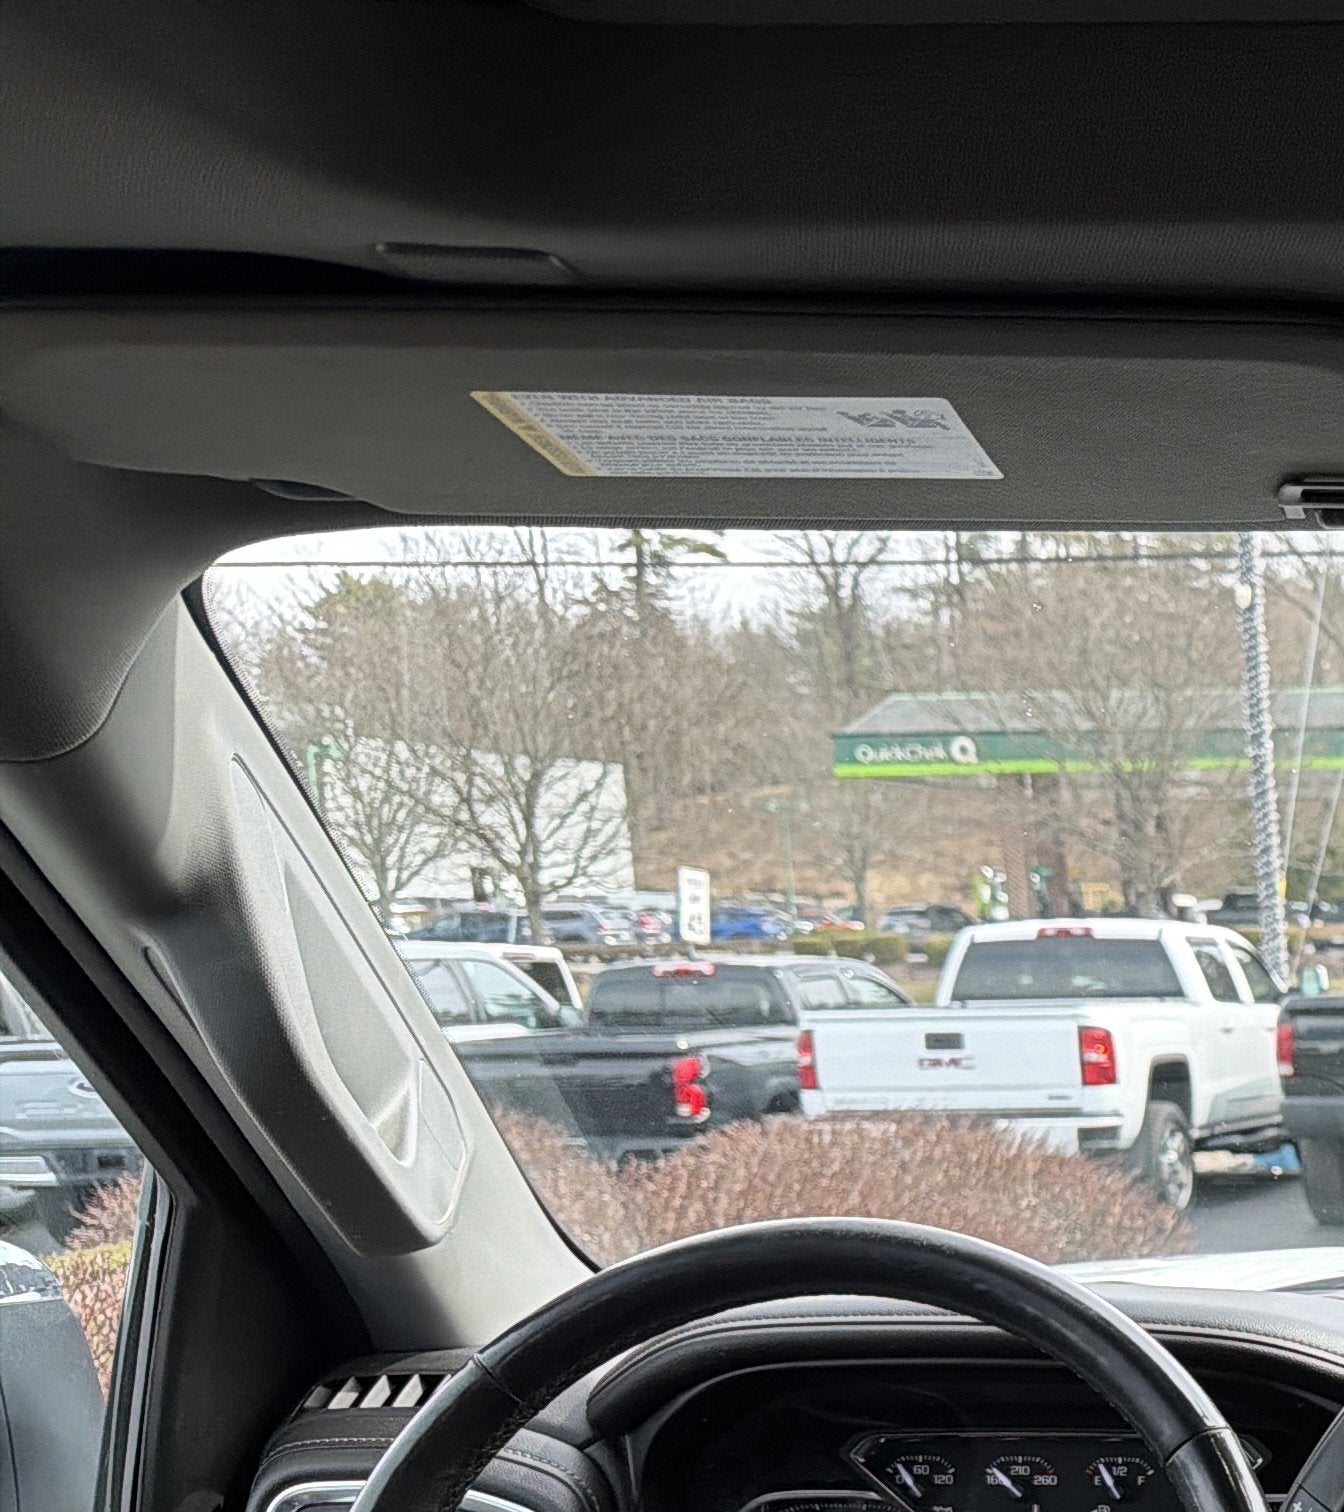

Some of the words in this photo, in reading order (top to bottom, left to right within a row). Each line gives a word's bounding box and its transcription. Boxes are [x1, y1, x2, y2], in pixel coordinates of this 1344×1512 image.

[913, 1466, 930, 1475] 60
[1010, 1466, 1031, 1476] 210
[1112, 1466, 1128, 1476] 1/2
[933, 1475, 953, 1485] 120
[1033, 1475, 1058, 1486] 260
[1137, 1476, 1146, 1486] F
